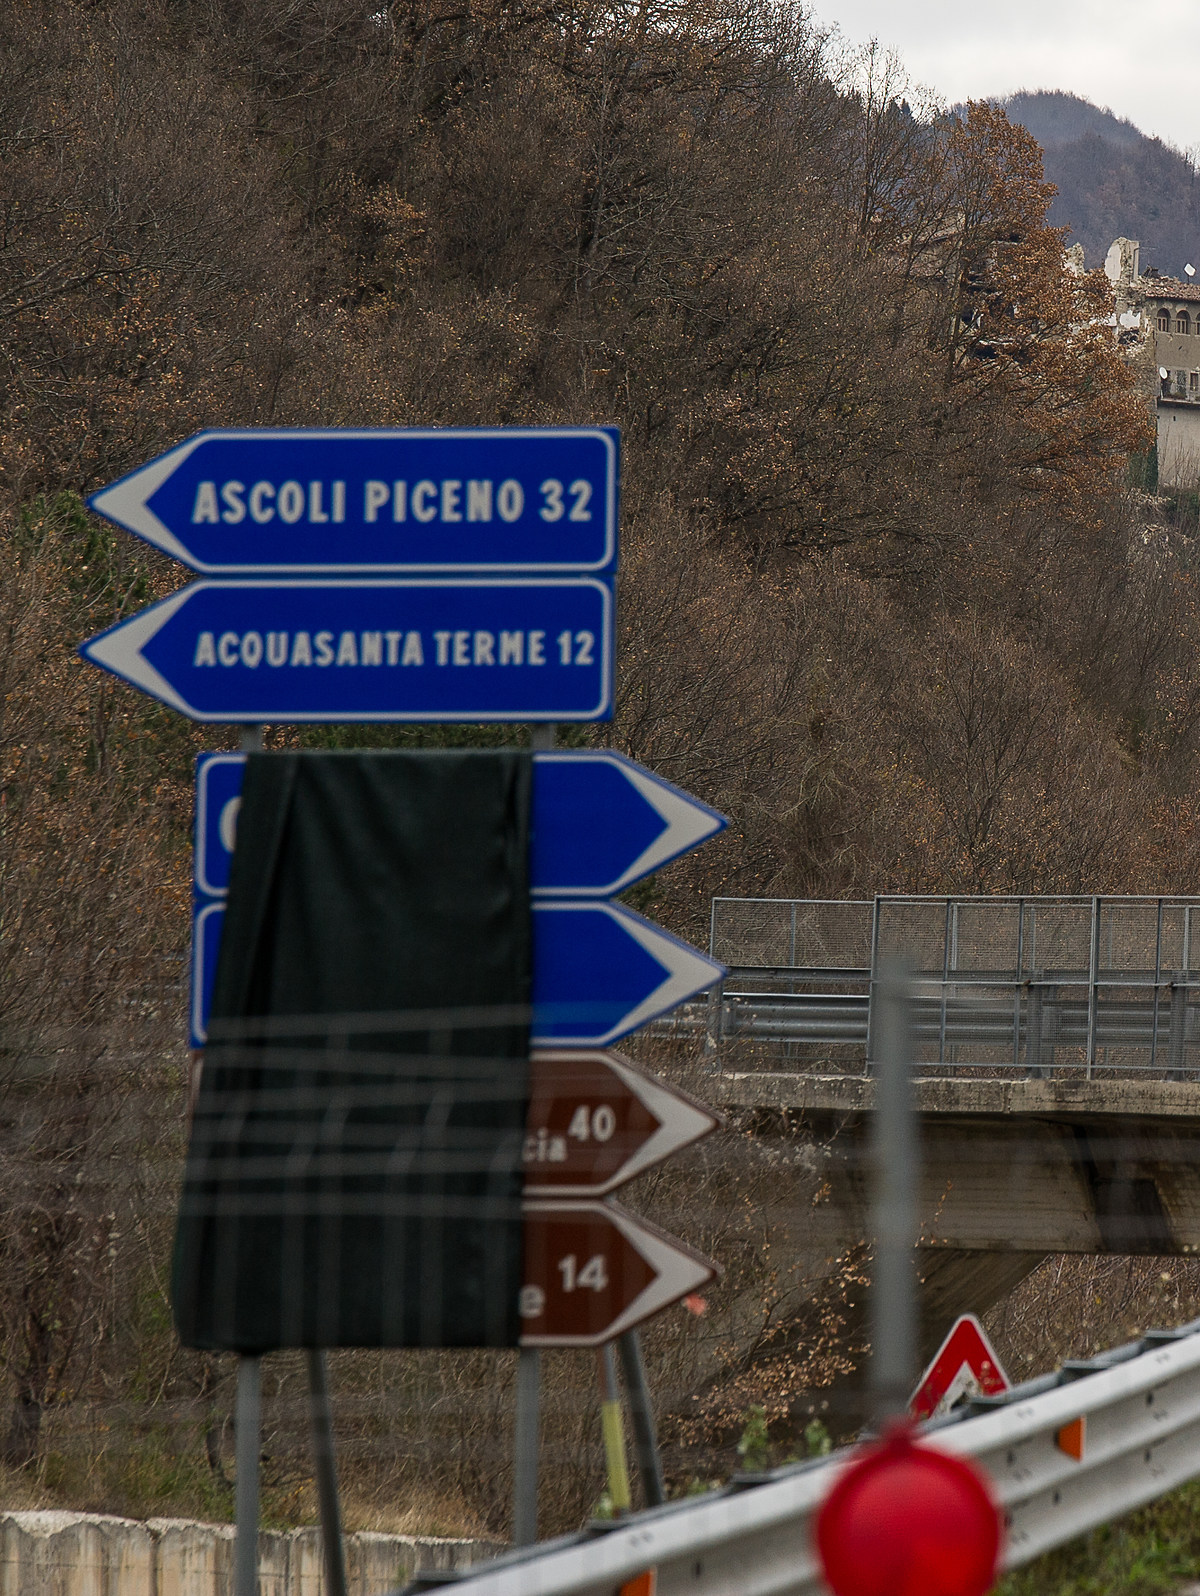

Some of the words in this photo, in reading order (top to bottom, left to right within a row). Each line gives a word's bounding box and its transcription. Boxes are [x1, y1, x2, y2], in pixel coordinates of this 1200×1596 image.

[191, 480, 346, 524] ASCOLI
[364, 478, 525, 523] PICENO
[538, 478, 593, 522] 32
[193, 631, 424, 669] ACQUASANTA
[433, 630, 546, 666] TERME
[556, 630, 595, 666] 12
[567, 1104, 616, 1142] 40
[557, 1254, 609, 1292] 14
